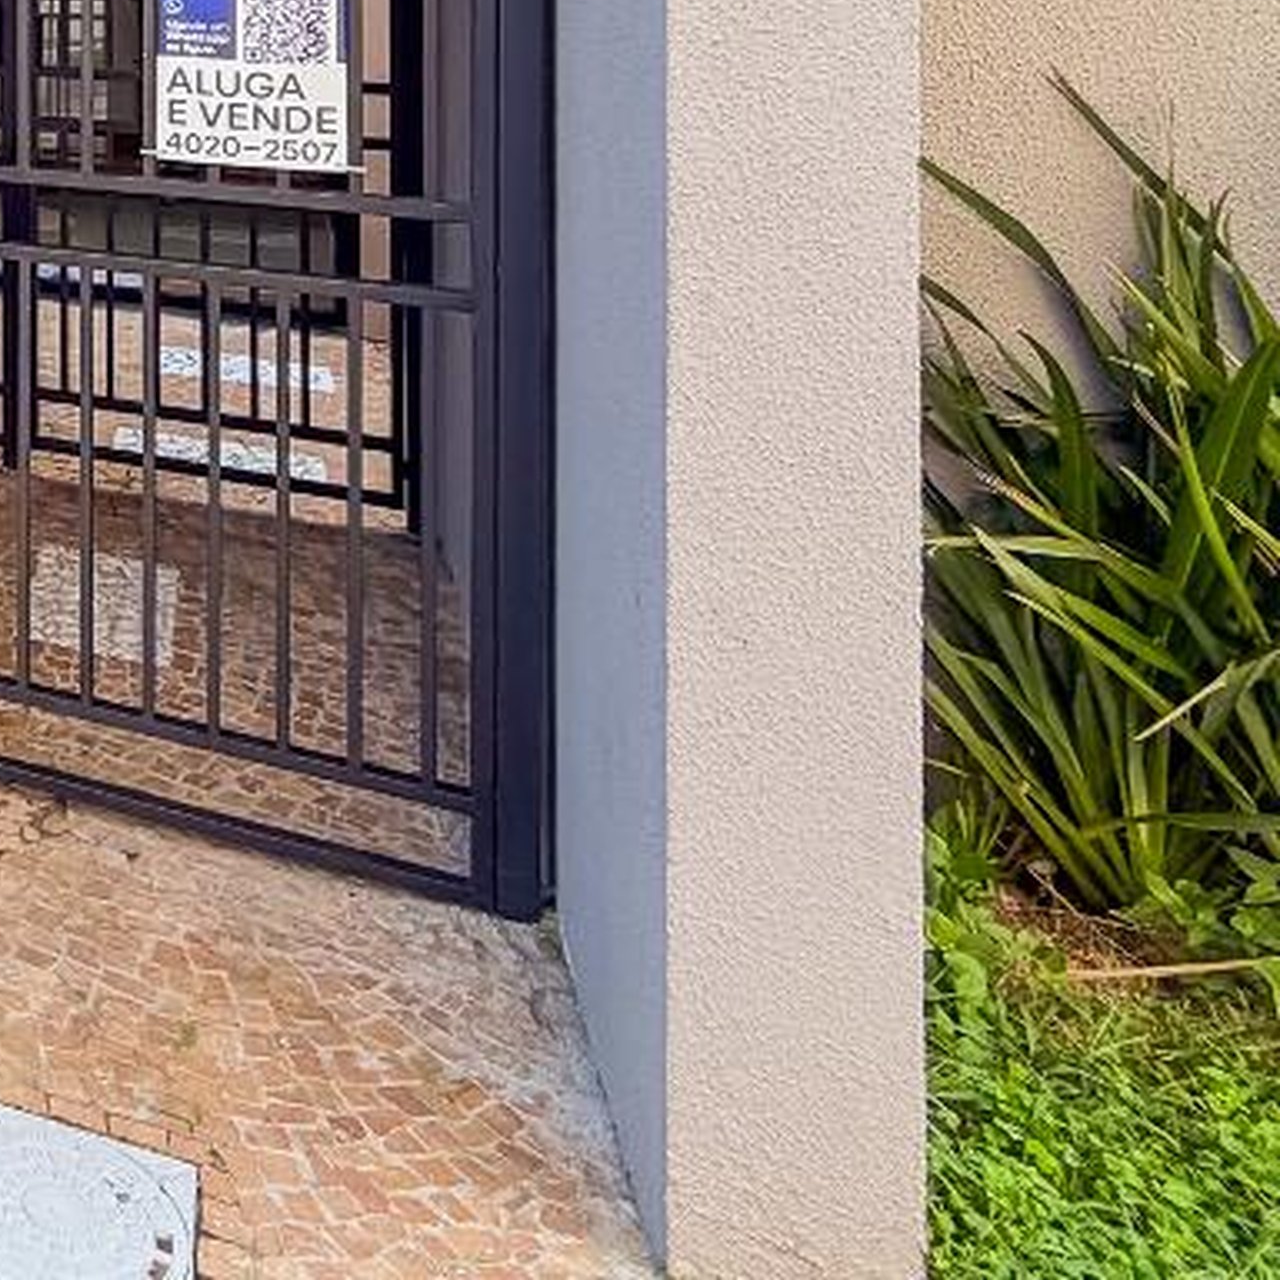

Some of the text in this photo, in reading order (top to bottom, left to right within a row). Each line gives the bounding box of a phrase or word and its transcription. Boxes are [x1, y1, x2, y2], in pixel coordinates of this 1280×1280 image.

[167, 67, 306, 100] ALUGA
[169, 100, 338, 134] E VENDE
[166, 132, 339, 163] 4020-2507
